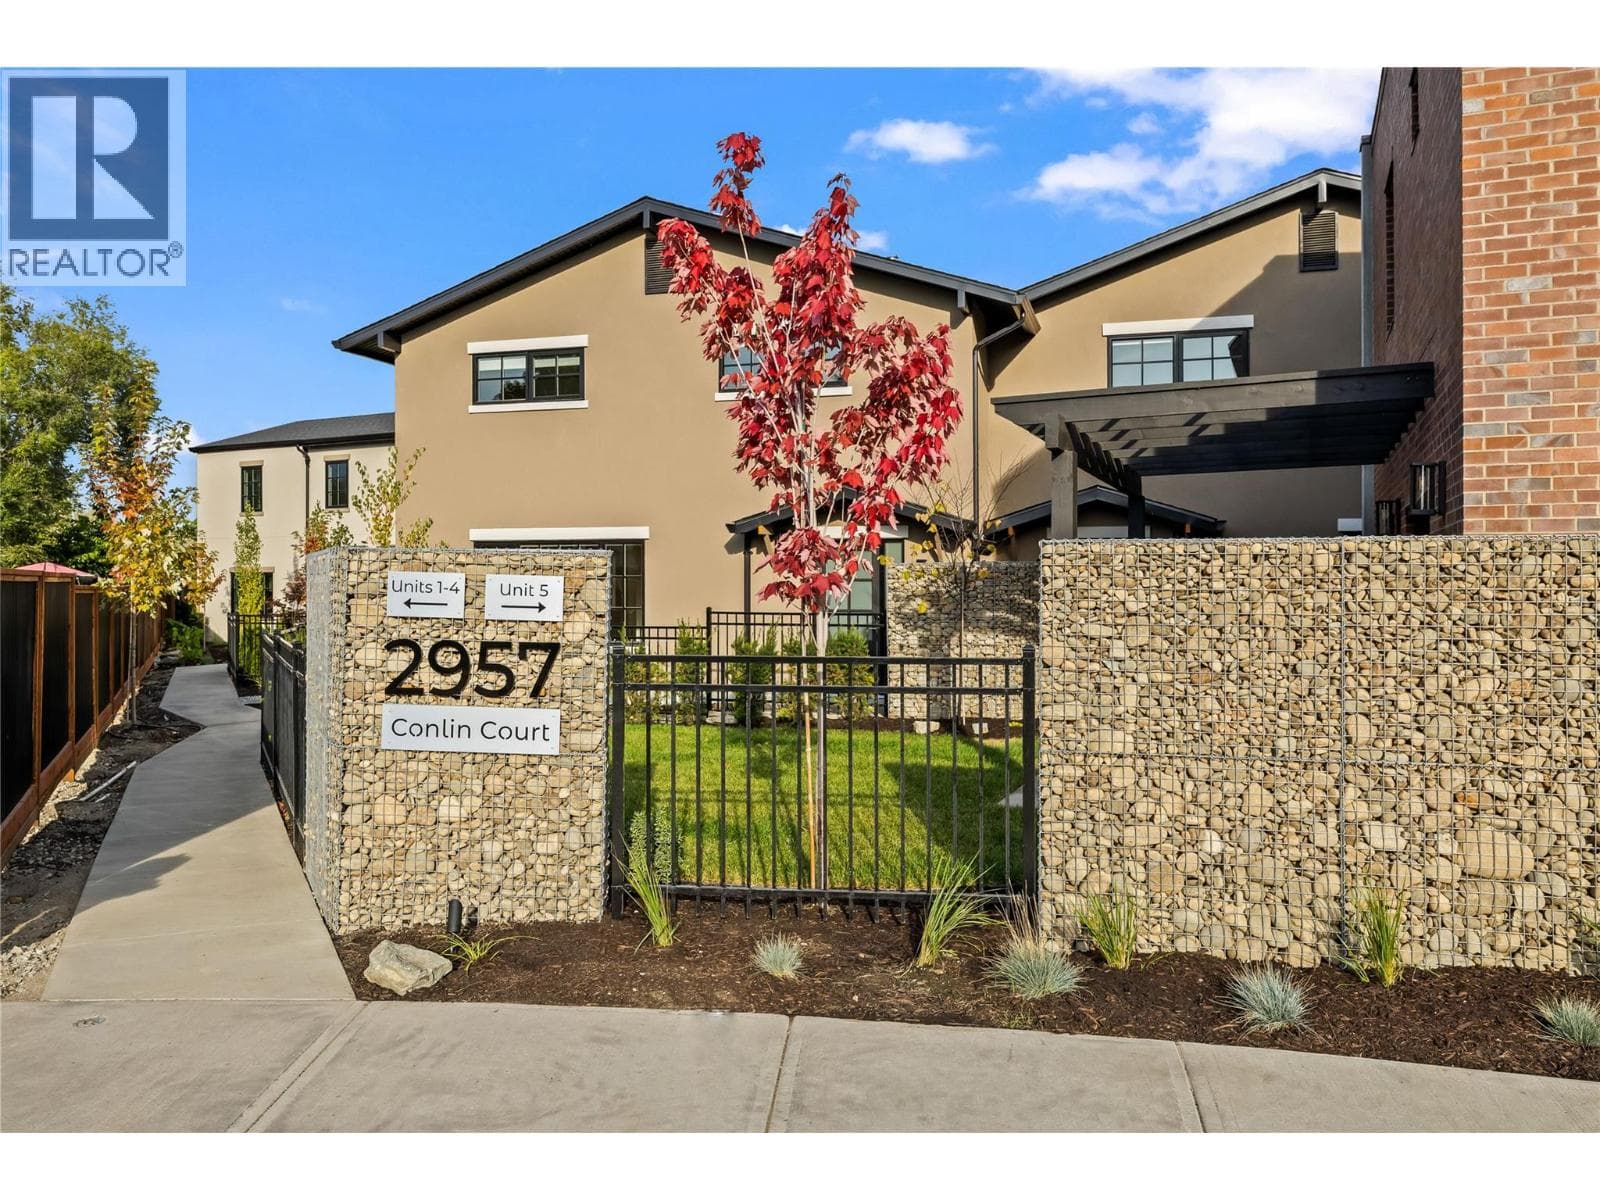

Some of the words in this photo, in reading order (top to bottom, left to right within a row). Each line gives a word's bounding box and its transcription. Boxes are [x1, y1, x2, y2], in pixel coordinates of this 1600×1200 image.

[391, 580, 433, 594] Units
[437, 581, 460, 594] 1-4
[500, 583, 534, 597] Unit
[539, 584, 549, 597] 5
[384, 638, 561, 698] 2957
[391, 718, 471, 739] Conlin
[480, 721, 550, 742] Court
